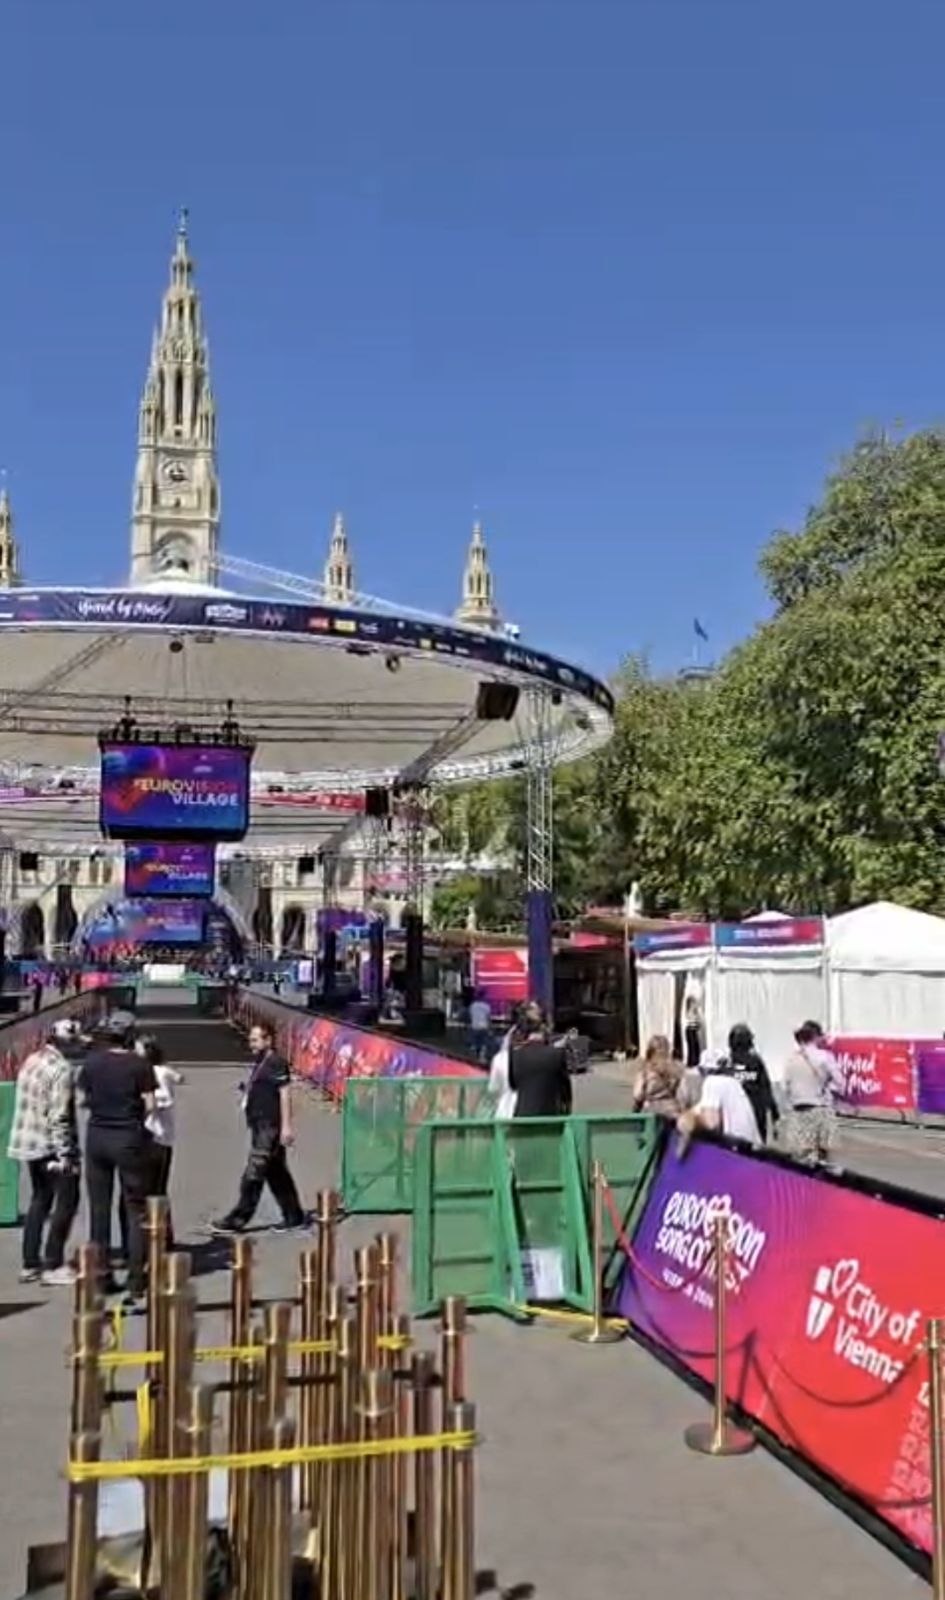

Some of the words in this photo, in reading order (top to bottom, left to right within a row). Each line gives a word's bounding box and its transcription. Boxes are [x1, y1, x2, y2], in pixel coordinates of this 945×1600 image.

[173, 793, 239, 806] VILLAGE
[845, 1282, 889, 1339] City
[887, 1309, 921, 1345] of
[833, 1316, 904, 1384] Vienna
